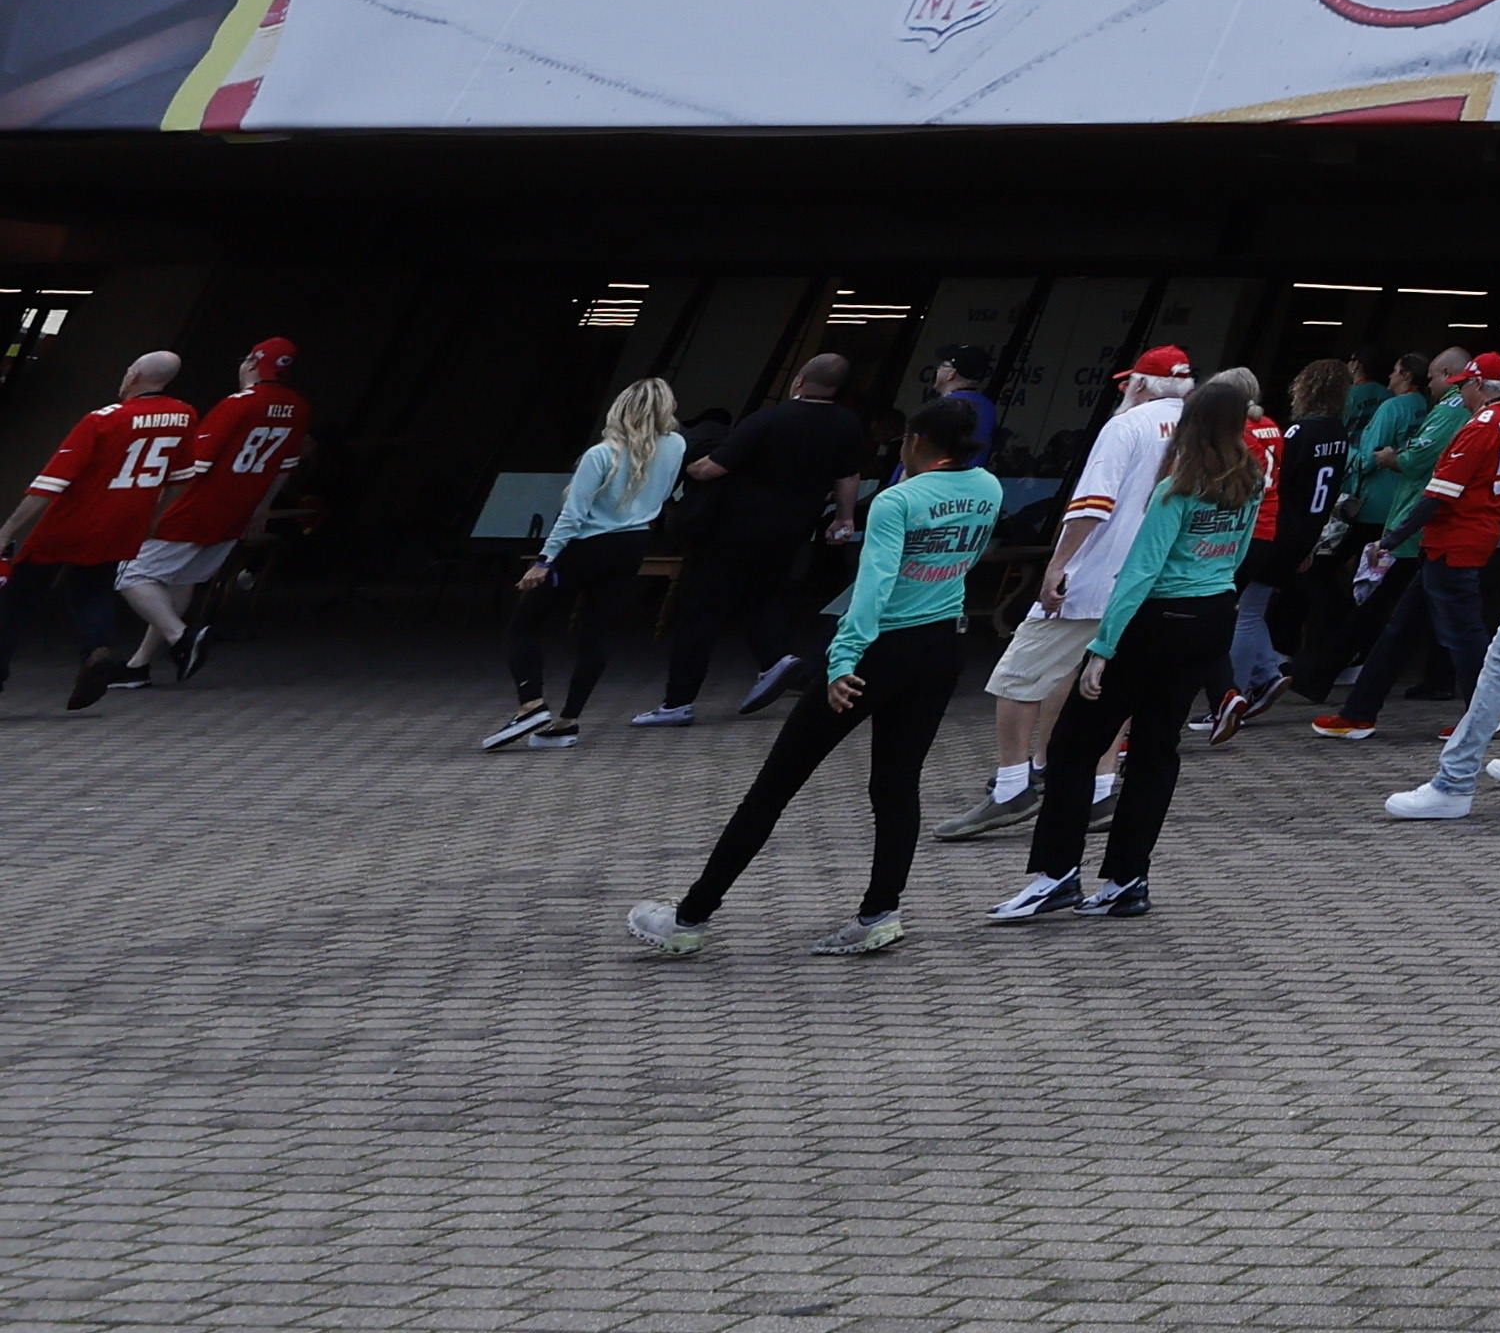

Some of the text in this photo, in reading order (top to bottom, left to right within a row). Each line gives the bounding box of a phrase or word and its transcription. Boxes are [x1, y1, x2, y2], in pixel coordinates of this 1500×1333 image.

[132, 413, 189, 430] MAHOMES
[1284, 424, 1300, 439] 6
[107, 436, 183, 490] 15
[231, 427, 293, 474] 87
[1309, 466, 1335, 514] 6
[929, 499, 994, 519] KREWE OF
